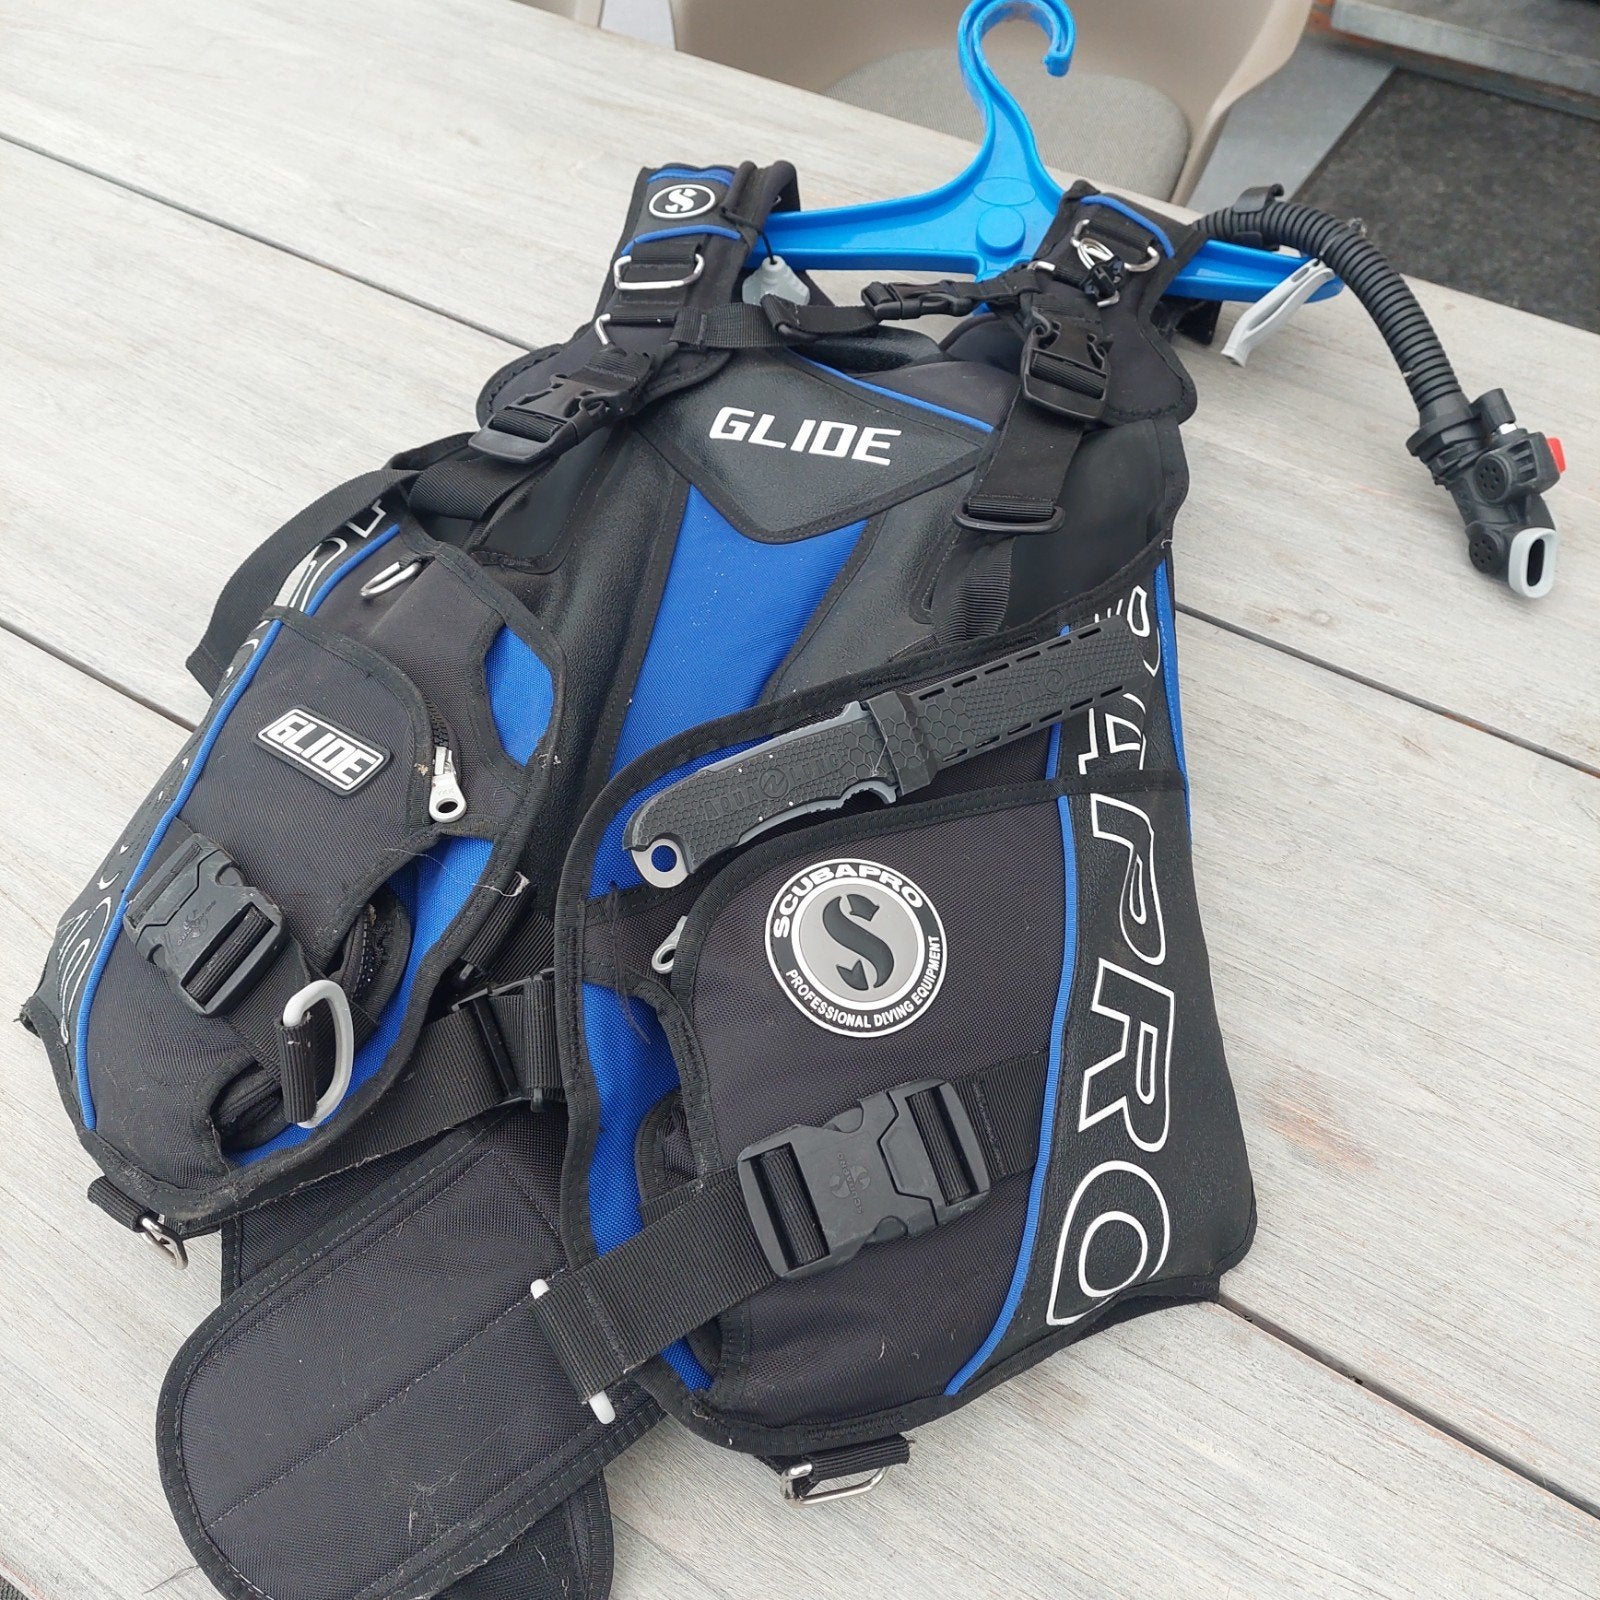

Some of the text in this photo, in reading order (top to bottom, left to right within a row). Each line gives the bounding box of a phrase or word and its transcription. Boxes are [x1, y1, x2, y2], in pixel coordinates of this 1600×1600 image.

[709, 406, 902, 466] GLIDE
[266, 714, 378, 784] GLIDE
[773, 863, 923, 938] SCUBAPRO
[786, 935, 941, 1028] PROFESSIONAL DIVING EQUIPMENT
